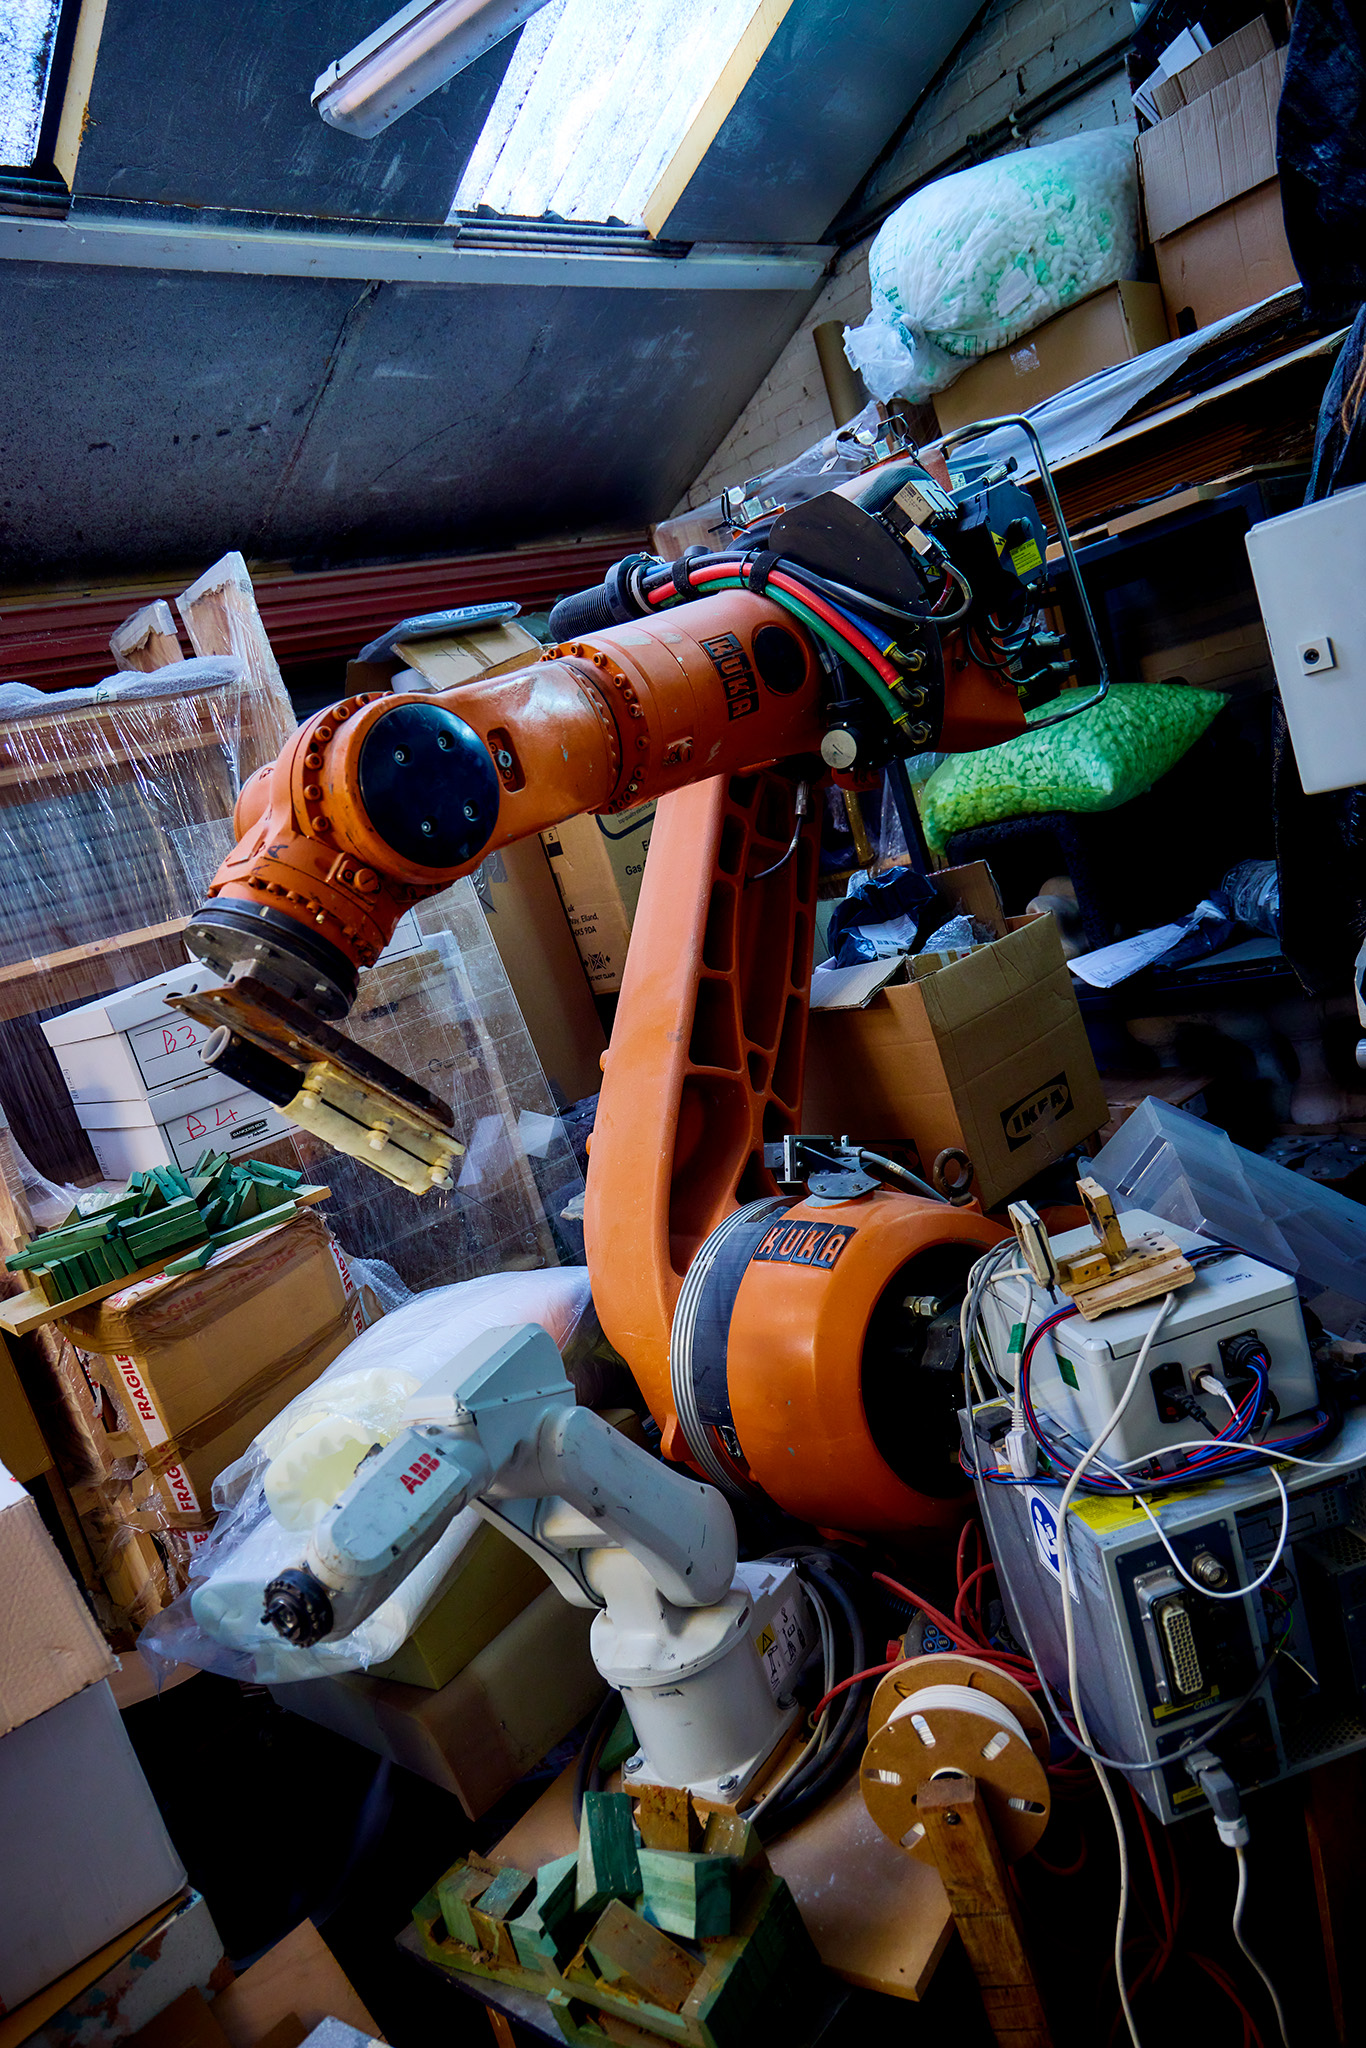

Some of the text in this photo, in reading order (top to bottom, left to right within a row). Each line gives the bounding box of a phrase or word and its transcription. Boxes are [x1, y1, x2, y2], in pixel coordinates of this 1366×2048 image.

[708, 636, 752, 717] KUKA
[548, 832, 554, 841] 5
[625, 862, 643, 876] Gas
[758, 1226, 847, 1263] KUKA
[116, 1354, 156, 1421] FRAGILE
[400, 1453, 440, 1495] ABB
